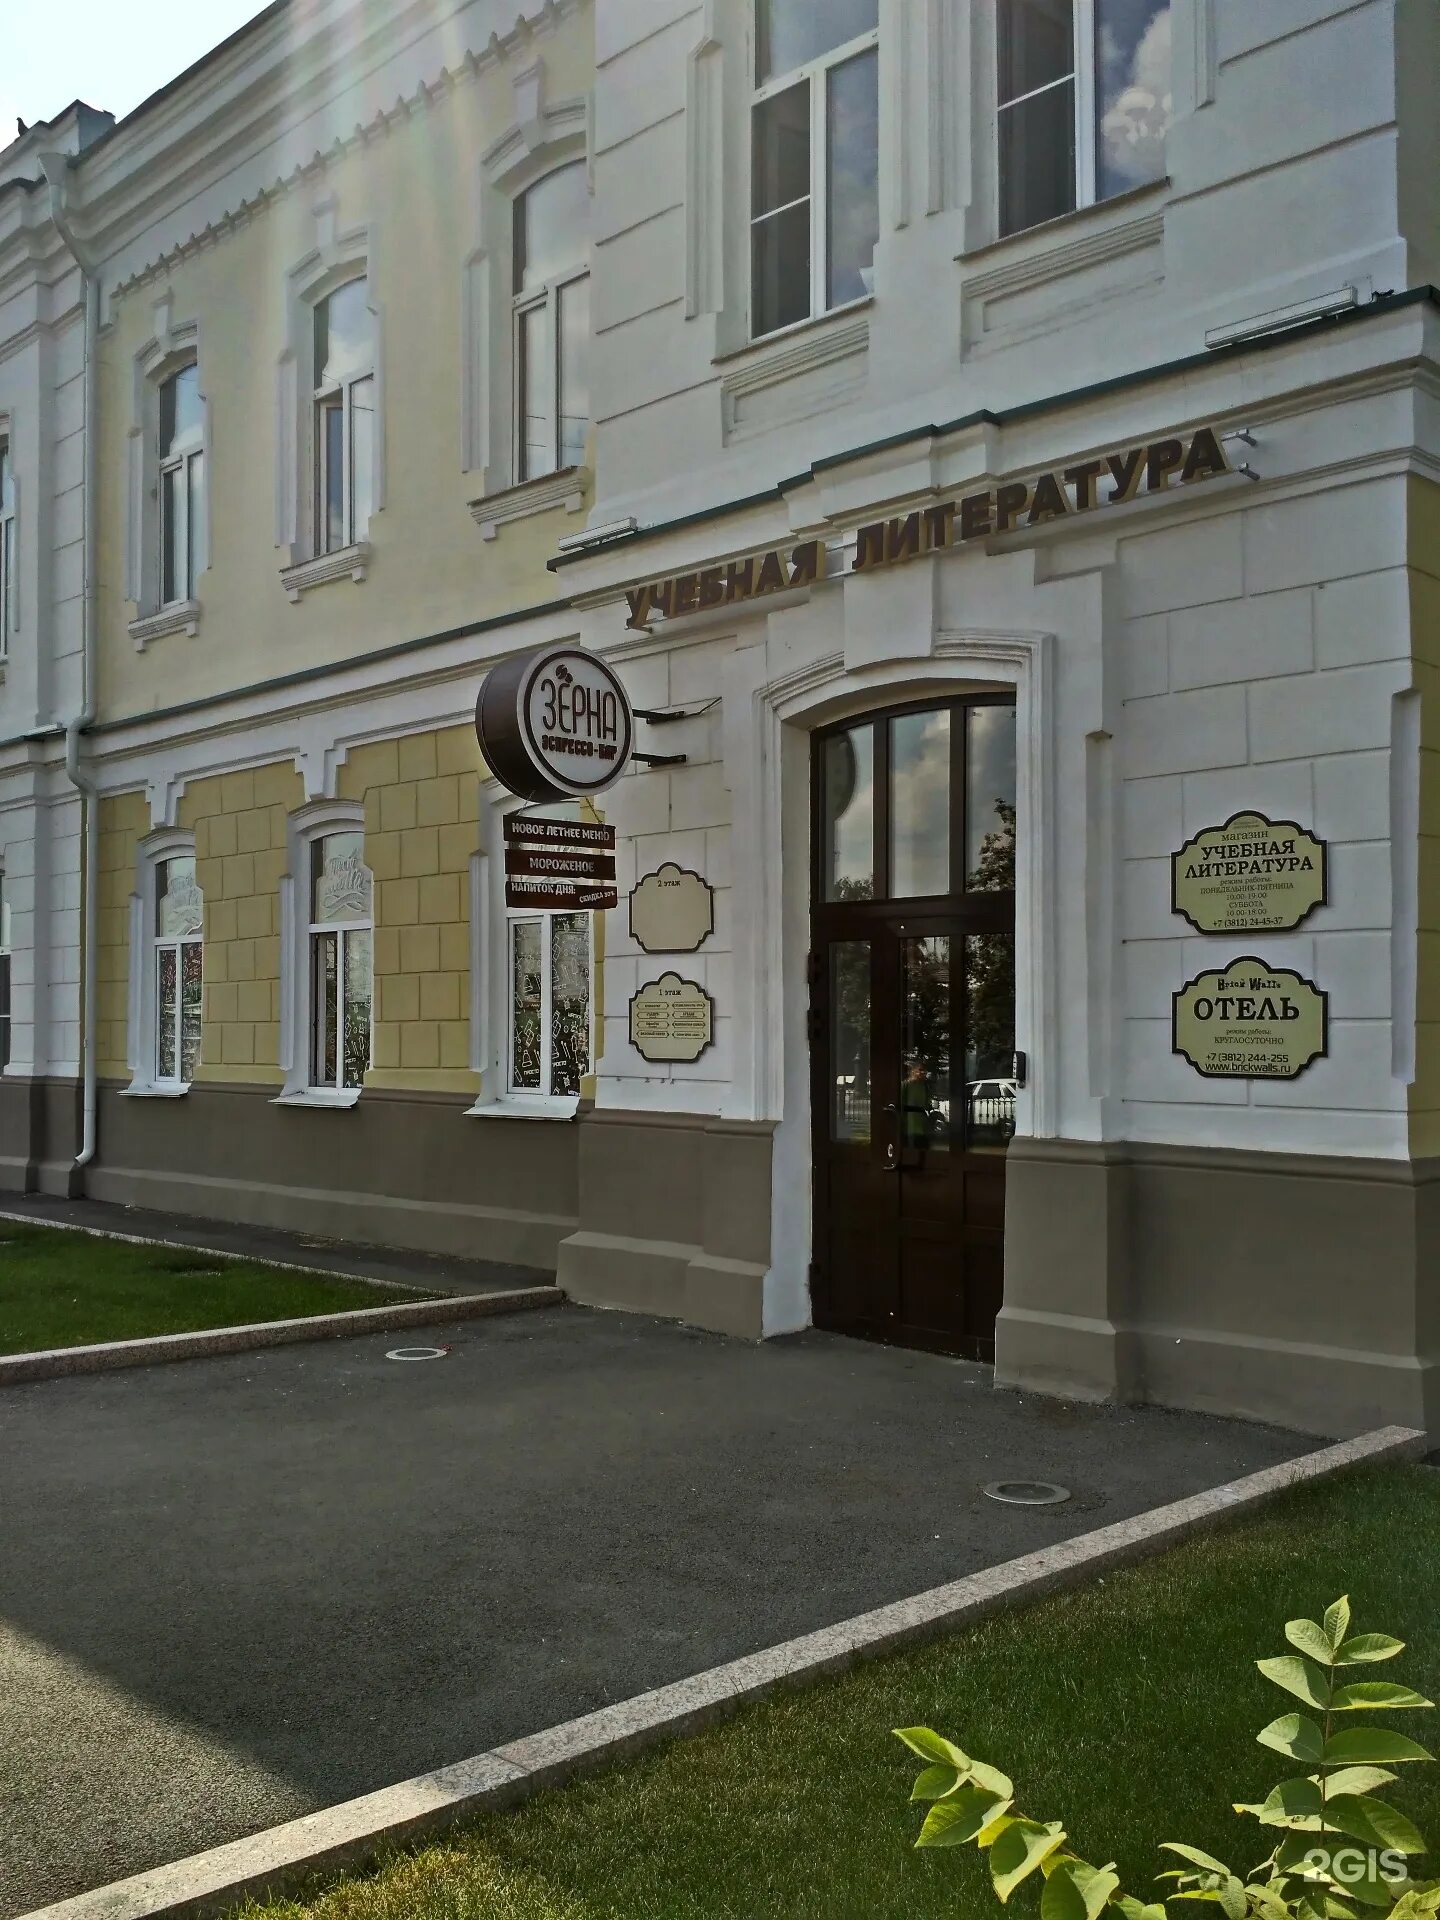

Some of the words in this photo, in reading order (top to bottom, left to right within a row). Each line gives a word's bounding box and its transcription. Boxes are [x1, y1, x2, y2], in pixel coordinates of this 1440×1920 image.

[625, 540, 826, 630] УЧЕБНАЯ
[850, 427, 1232, 573] ЛИТЕРАТУРА
[511, 822, 545, 835] НОВОЕ
[546, 826, 581, 838] ЛЕТНЕЕ
[582, 828, 610, 841] МЕНЮ
[1221, 830, 1269, 842] магазин
[1201, 839, 1295, 860] УЧЕБНАЯ
[529, 857, 595, 872] МОРОЖЕНОЕ
[1184, 855, 1314, 878] ЛИТЕРАТУРА
[511, 882, 554, 893] НАПИТОК
[555, 885, 576, 895] ДНЯ:
[657, 879, 662, 888] 2
[1212, 919, 1223, 928] +7
[1224, 918, 1248, 928] (3812)
[1249, 916, 1284, 927] 24-45-37
[1193, 997, 1300, 1021] ОТЕЛЬ
[1214, 1036, 1284, 1045] КРУГЛОСУТОЧНО
[1206, 1052, 1217, 1062] +7
[1218, 1053, 1246, 1063] (3812)
[1247, 1053, 1289, 1063] 244-255
[1204, 1062, 1291, 1073] www.brickwalls.ru
